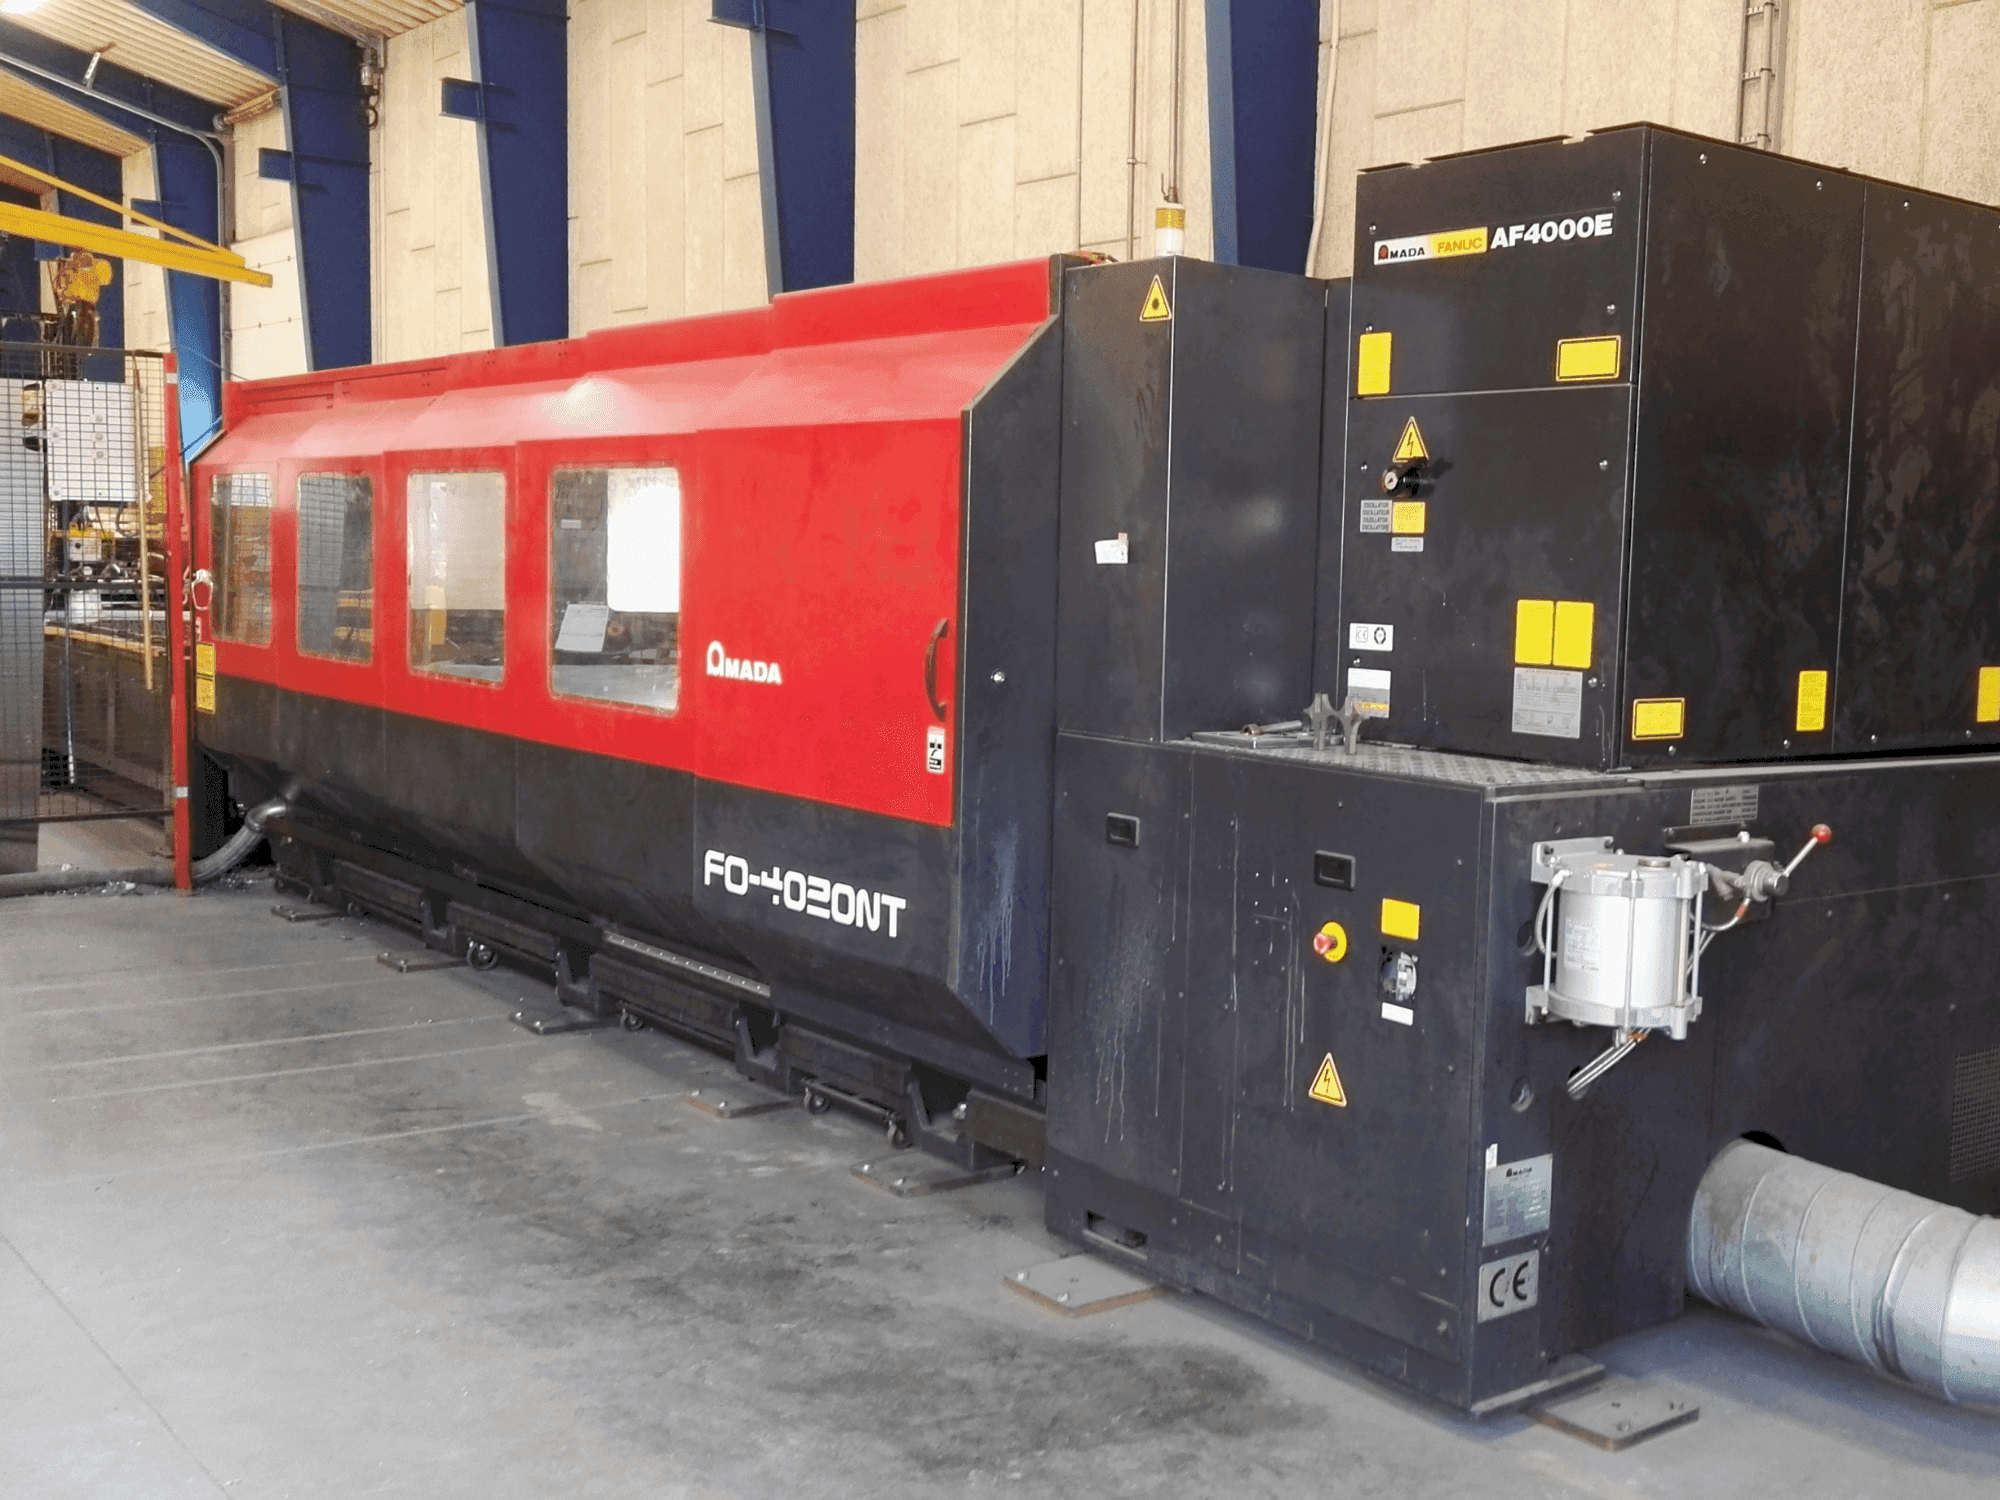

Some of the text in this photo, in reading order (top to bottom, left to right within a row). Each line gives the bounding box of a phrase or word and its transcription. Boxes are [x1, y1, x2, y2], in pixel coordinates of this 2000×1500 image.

[1378, 213, 1614, 260] AMADA FANUC AF4000E
[706, 640, 783, 684] AMADA
[704, 849, 906, 938] FO-4020NT
[1489, 1260, 1529, 1308] CE
